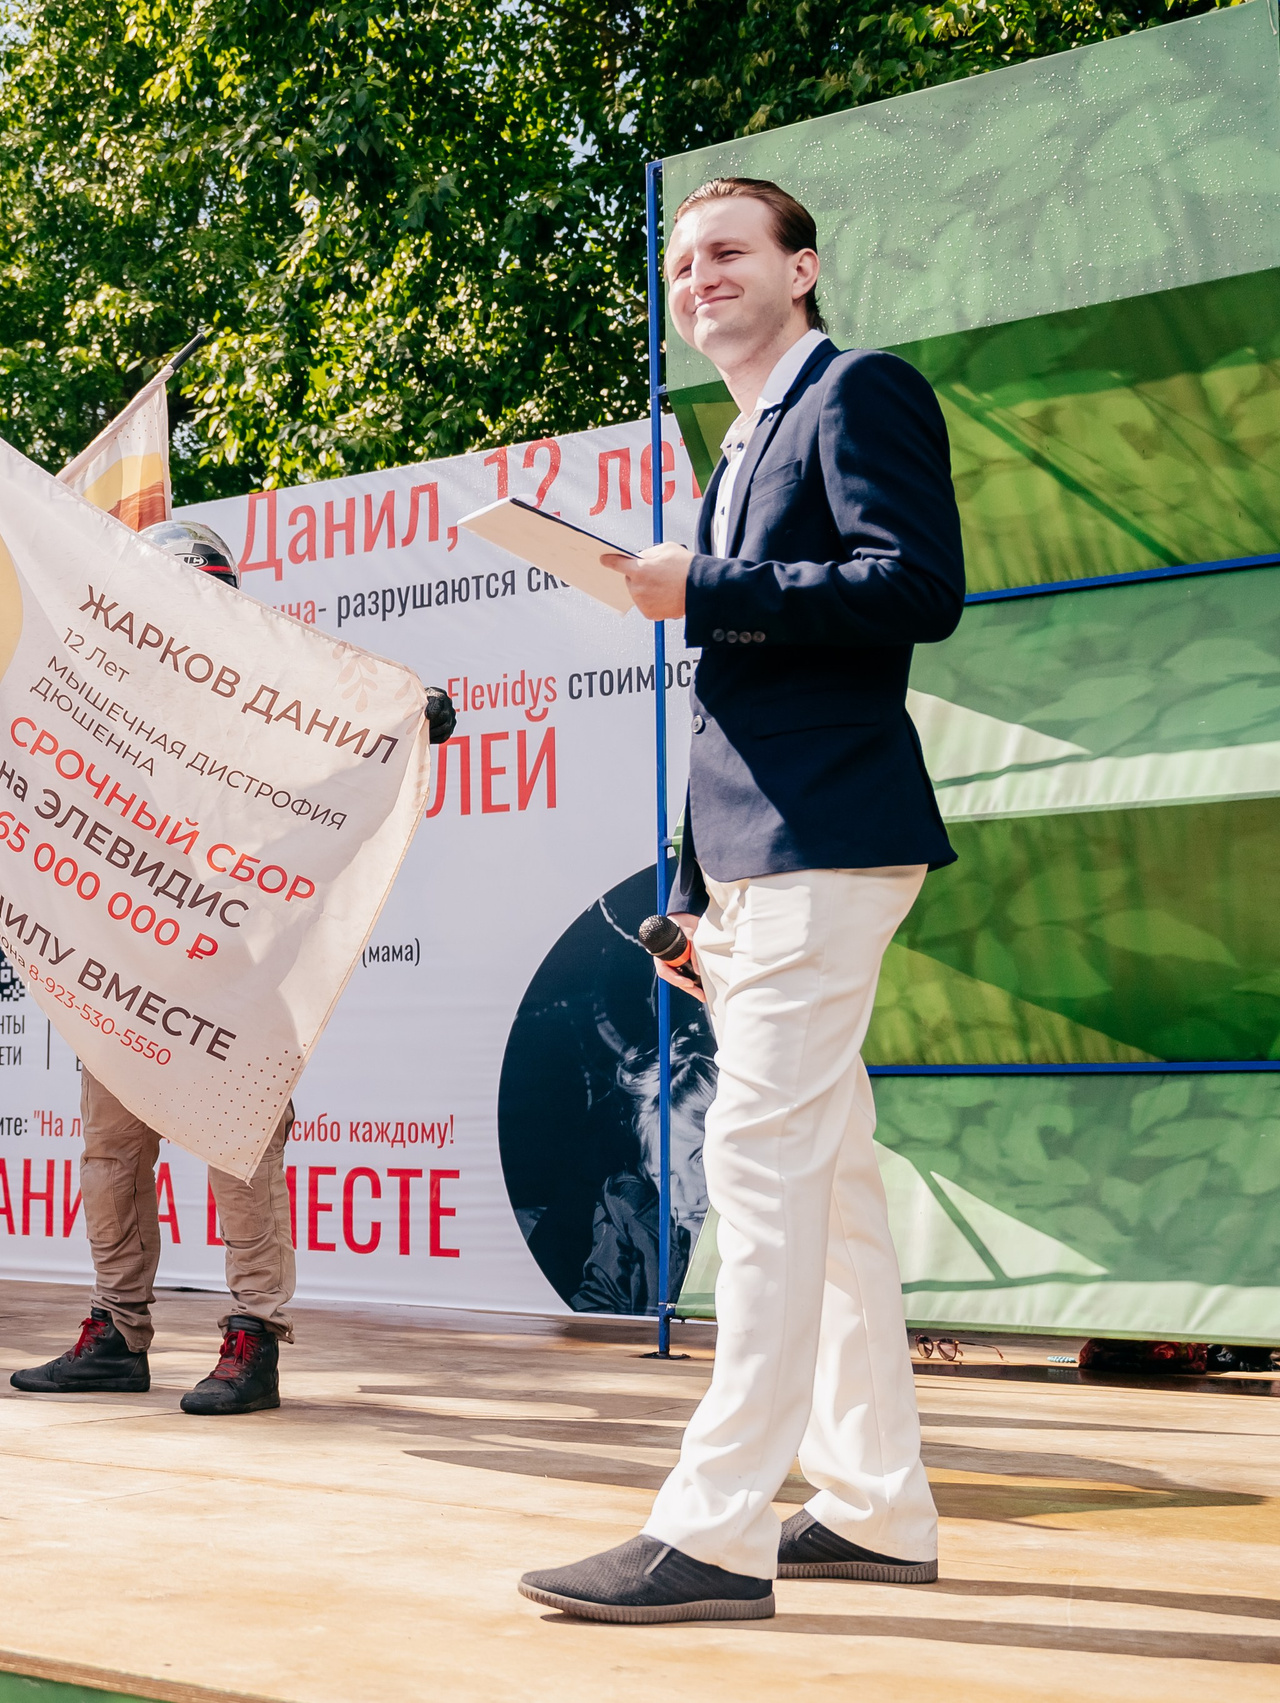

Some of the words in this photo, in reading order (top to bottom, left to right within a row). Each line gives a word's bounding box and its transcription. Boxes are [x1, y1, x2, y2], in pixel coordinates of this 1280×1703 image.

[237, 481, 459, 589] Данил,
[337, 569, 516, 628] разрушаются
[527, 566, 571, 592] ск
[63, 627, 86, 654] 12
[84, 646, 130, 683] Лет
[79, 584, 241, 699] ЖАРКОВ
[242, 684, 400, 765] ДАНИЛ
[447, 669, 558, 713] Elevidys
[567, 659, 701, 700] стоимос
[29, 676, 156, 777] ДЮШЕННА
[47, 655, 188, 757] МЫШЕЧНАЯ
[186, 749, 348, 831] ДИСТРОФИЯ
[10, 716, 202, 856] СРОЧНЫЙ
[206, 843, 316, 902] СБОР
[33, 787, 250, 928] ЭЛЕВИДИС
[33, 842, 101, 901] 000
[107, 891, 181, 946] 000
[362, 937, 421, 969] (мама)
[28, 963, 172, 1067] 8-923-530-5550
[77, 957, 237, 1062] ВМЕСТЕ
[287, 1112, 341, 1143] сибо
[349, 1114, 455, 1149] каждому!
